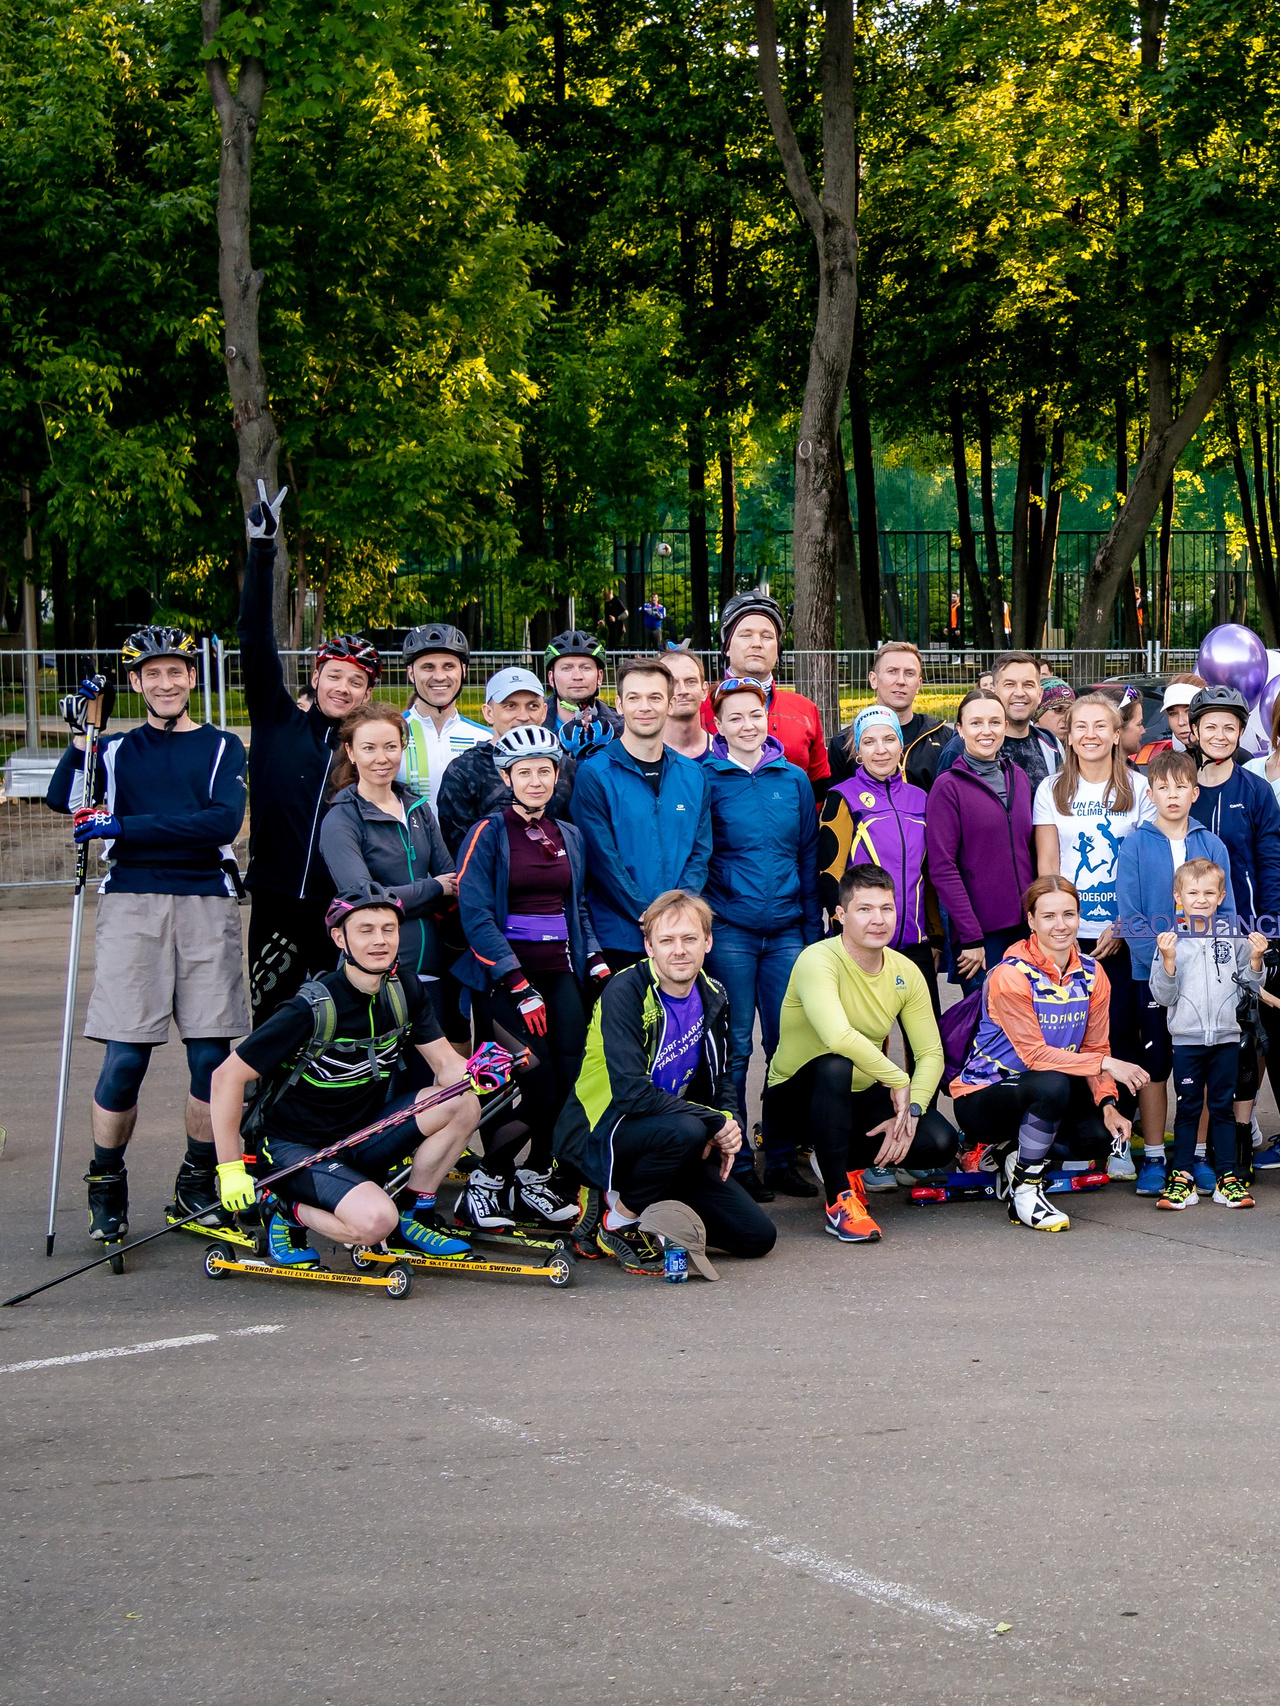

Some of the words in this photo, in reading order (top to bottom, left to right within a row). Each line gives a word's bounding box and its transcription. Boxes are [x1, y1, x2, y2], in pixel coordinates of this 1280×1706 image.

[1072, 801, 1087, 810] UN
[1077, 808, 1103, 817] CLIMB
[1038, 1010, 1087, 1024] OLDFINCH
[244, 1264, 274, 1274] SWENOR
[295, 1271, 314, 1279] EXTRA
[331, 1274, 362, 1283] SWENOR
[489, 1265, 522, 1273] SWENOR
